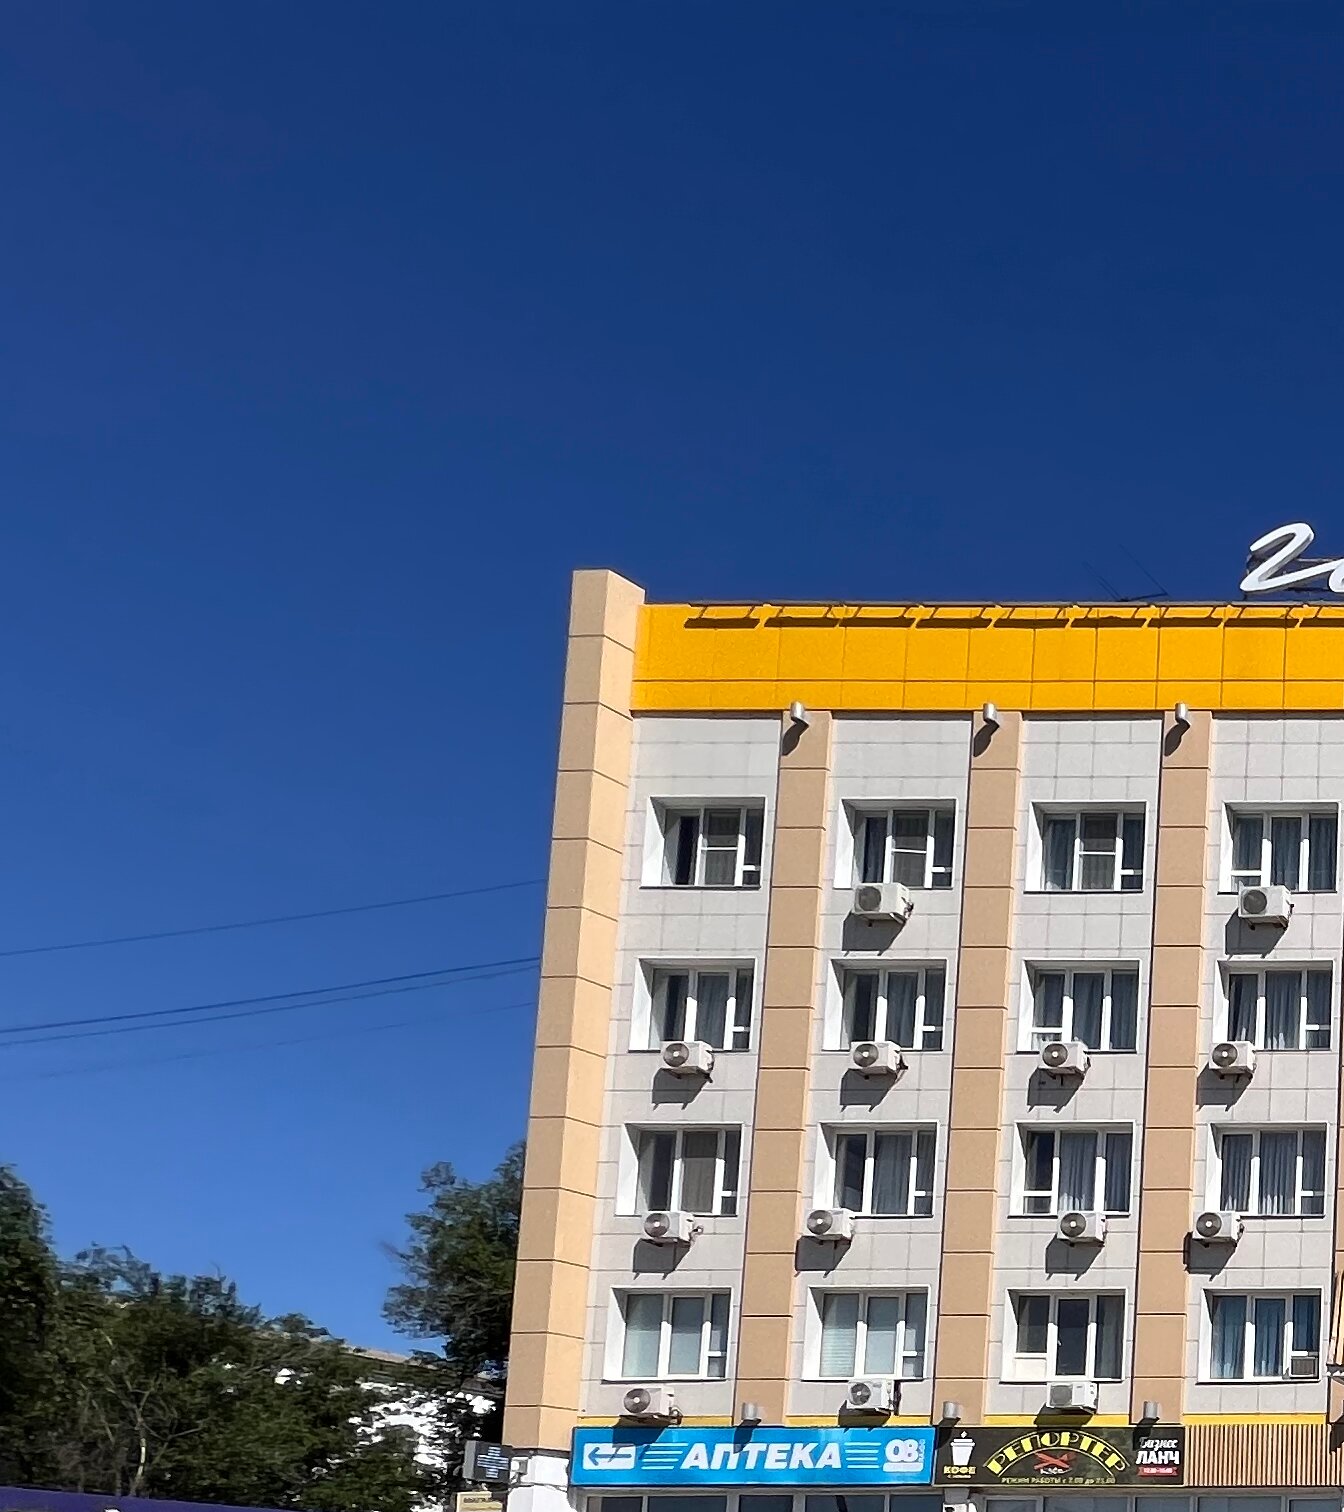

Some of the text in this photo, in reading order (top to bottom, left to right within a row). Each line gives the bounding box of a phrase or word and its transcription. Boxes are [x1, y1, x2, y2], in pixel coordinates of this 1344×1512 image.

[680, 1442, 842, 1470] АПТЕКА
[986, 1430, 1127, 1476] РЕПОРТЕР
[1135, 1450, 1180, 1465] ЛАНЧ
